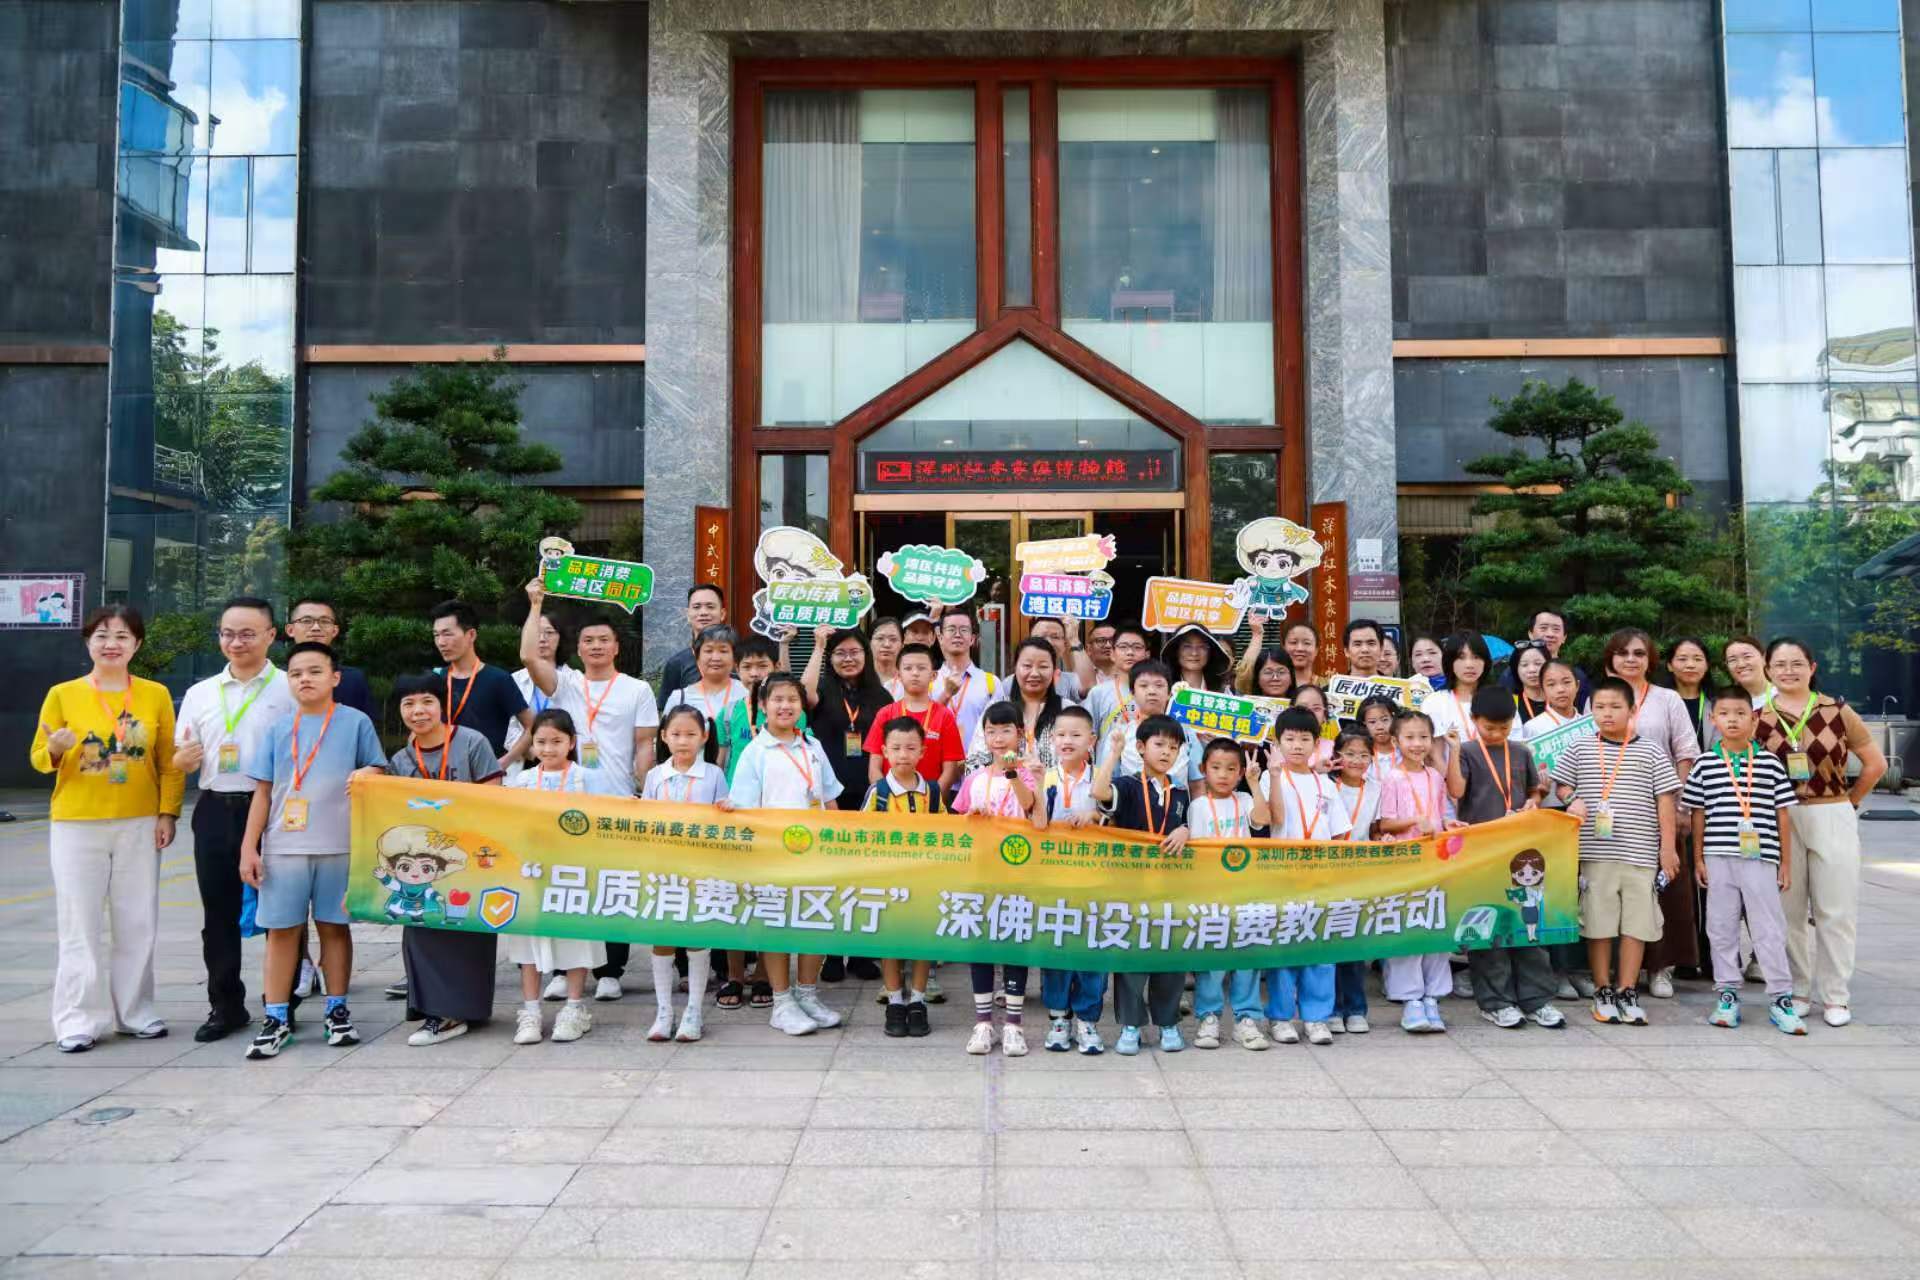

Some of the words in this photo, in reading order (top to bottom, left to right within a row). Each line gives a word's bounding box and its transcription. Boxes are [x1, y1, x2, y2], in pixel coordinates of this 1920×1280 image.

[706, 523, 720, 585] 中式古
[567, 560, 632, 580] 品质消费
[569, 577, 642, 600] 湾区同行
[772, 586, 841, 603] 匠心传承
[1029, 577, 1087, 594] 品质消费
[777, 606, 850, 624] 品质消费
[1028, 596, 1102, 617] 湾区同行
[1335, 679, 1403, 700] 匠心传承
[596, 816, 756, 842] 深圳市消费者委员会
[819, 828, 974, 848] 佛山市消费者委员会
[819, 845, 861, 857] Foshan
[864, 848, 924, 860] Consumer
[926, 851, 972, 863] Council
[1256, 843, 1422, 862] 深圳市龙华区消费者委员会
[1100, 861, 1152, 870] CONSUMER
[1154, 862, 1195, 871] COUNCIL
[935, 885, 1447, 951] 深佛中设计消费教育活动
